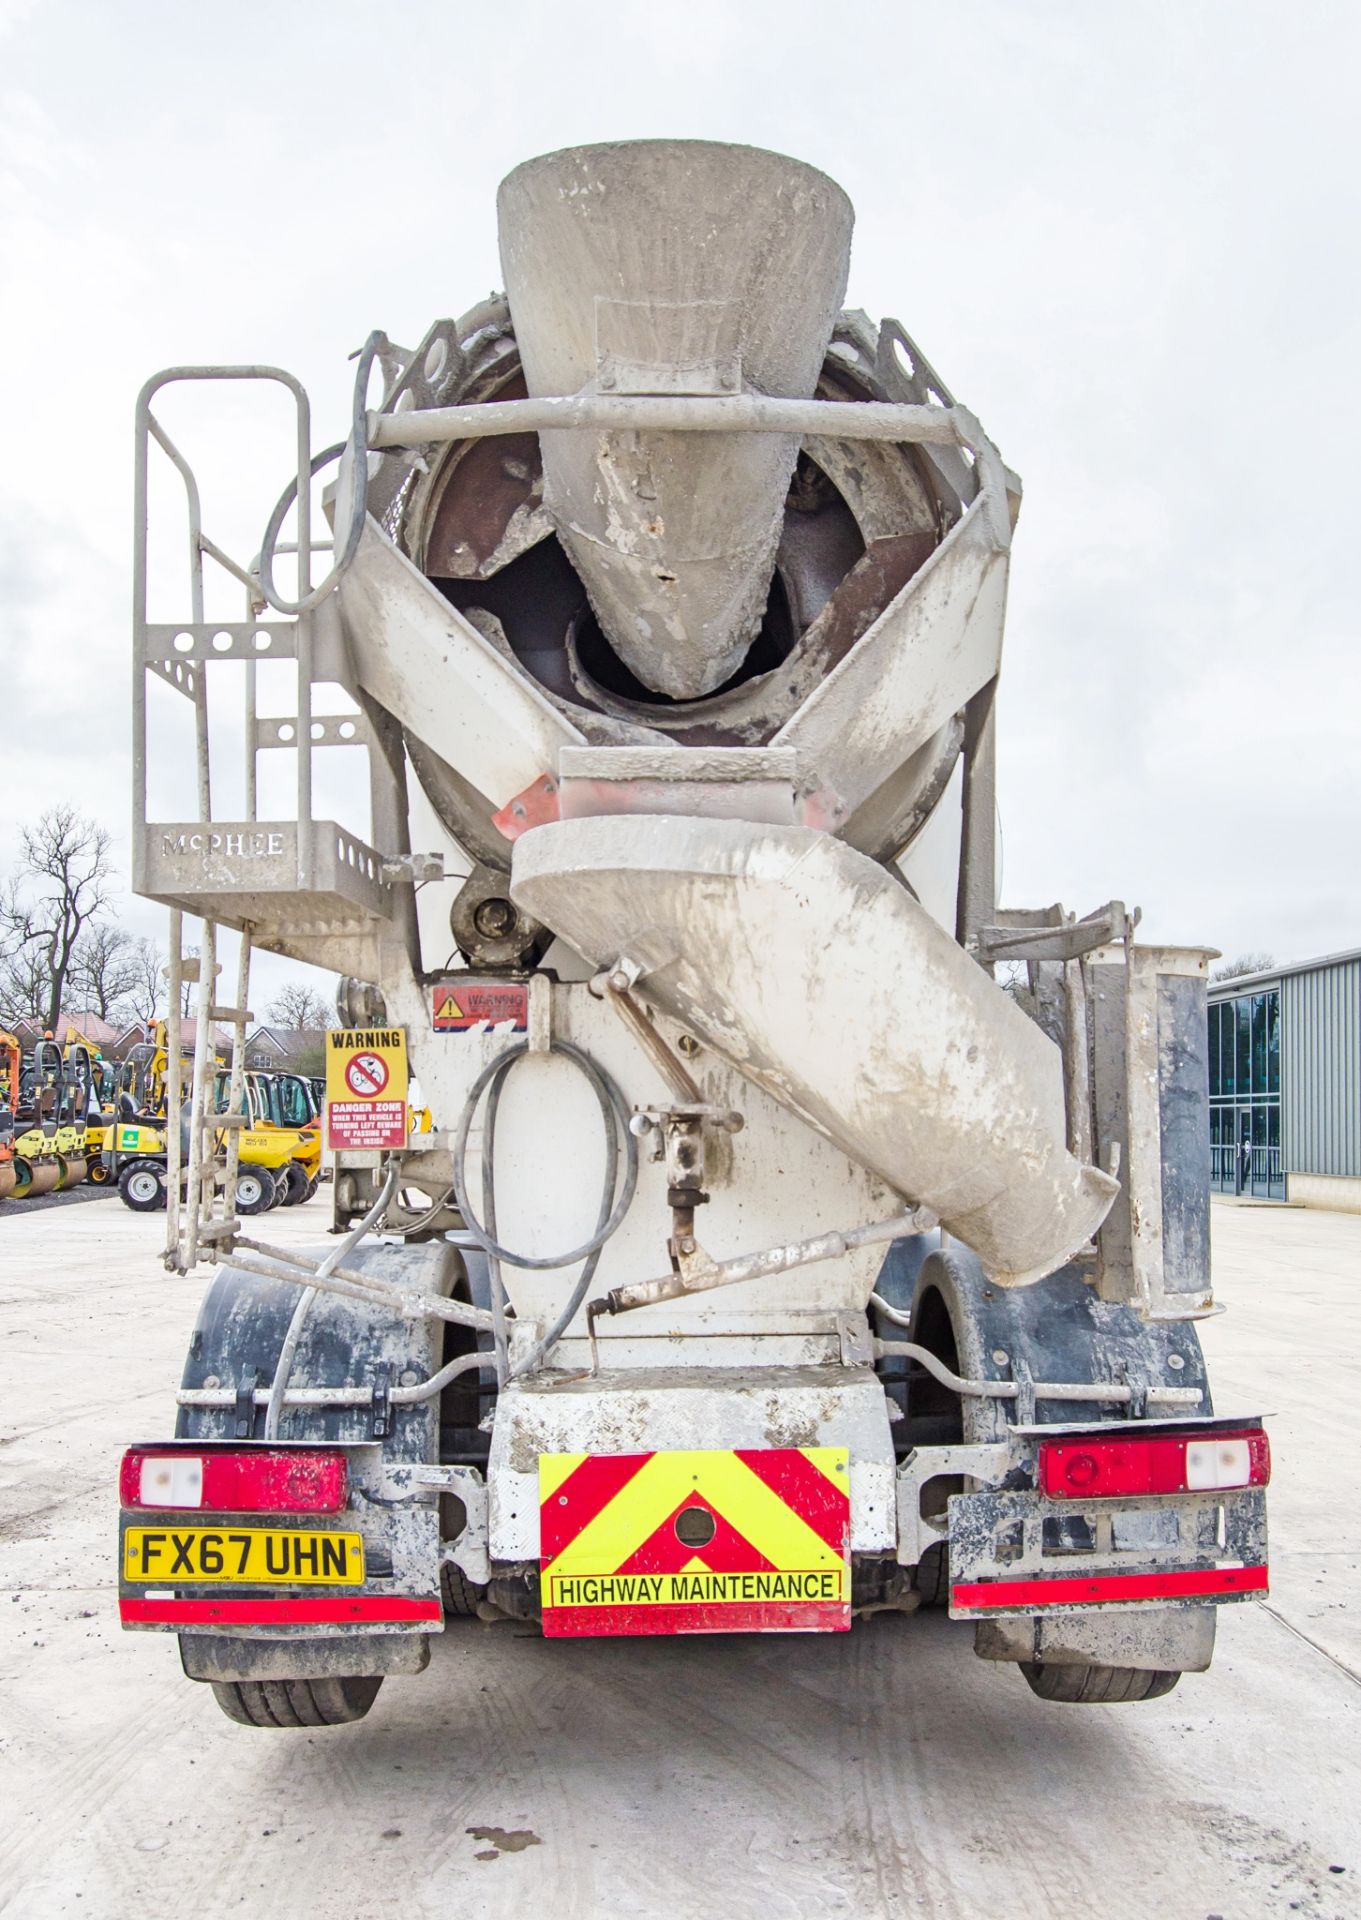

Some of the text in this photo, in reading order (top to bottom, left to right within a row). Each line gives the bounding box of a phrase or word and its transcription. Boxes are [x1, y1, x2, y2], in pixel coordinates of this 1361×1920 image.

[468, 994, 523, 1006] WARNING
[332, 1031, 401, 1049] WARNING
[332, 1102, 402, 1113] DANGER ZONE
[332, 1112, 402, 1122] WHEN THIS VEHICLE IS
[332, 1121, 402, 1130] TURNING LEFT BEWARE
[343, 1129, 391, 1138] OF PASSING ON
[349, 1137, 385, 1145] THE INSIDE
[141, 1534, 347, 1577] FX67 UHN
[559, 1574, 834, 1603] HIGHWAY MAINTENANCE
